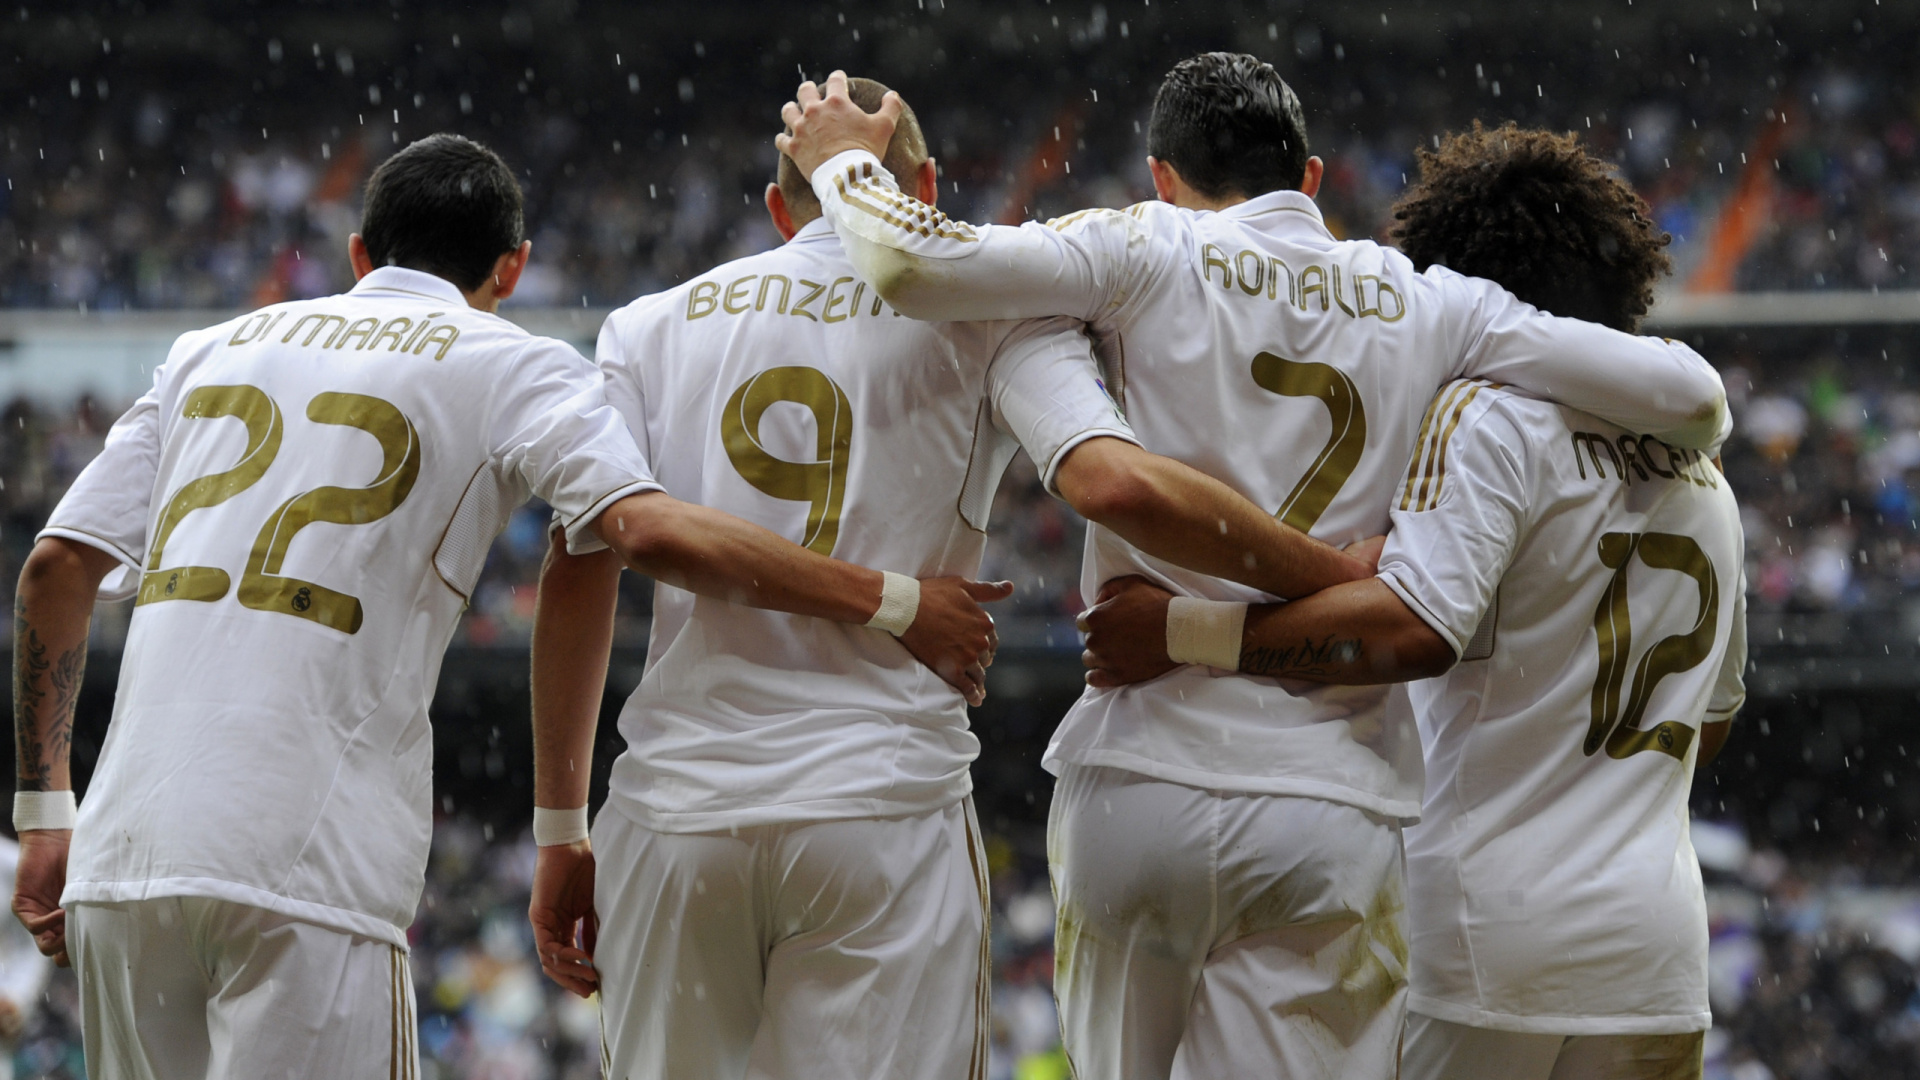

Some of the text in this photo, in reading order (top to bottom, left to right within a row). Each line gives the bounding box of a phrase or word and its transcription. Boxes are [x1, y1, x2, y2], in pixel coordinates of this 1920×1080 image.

[228, 311, 461, 361] DI MARÍA
[1202, 243, 1406, 323] RONALDO
[134, 384, 421, 635] 22
[720, 365, 853, 558] 9
[1250, 351, 1367, 535] 7
[1583, 531, 1720, 761] 12
